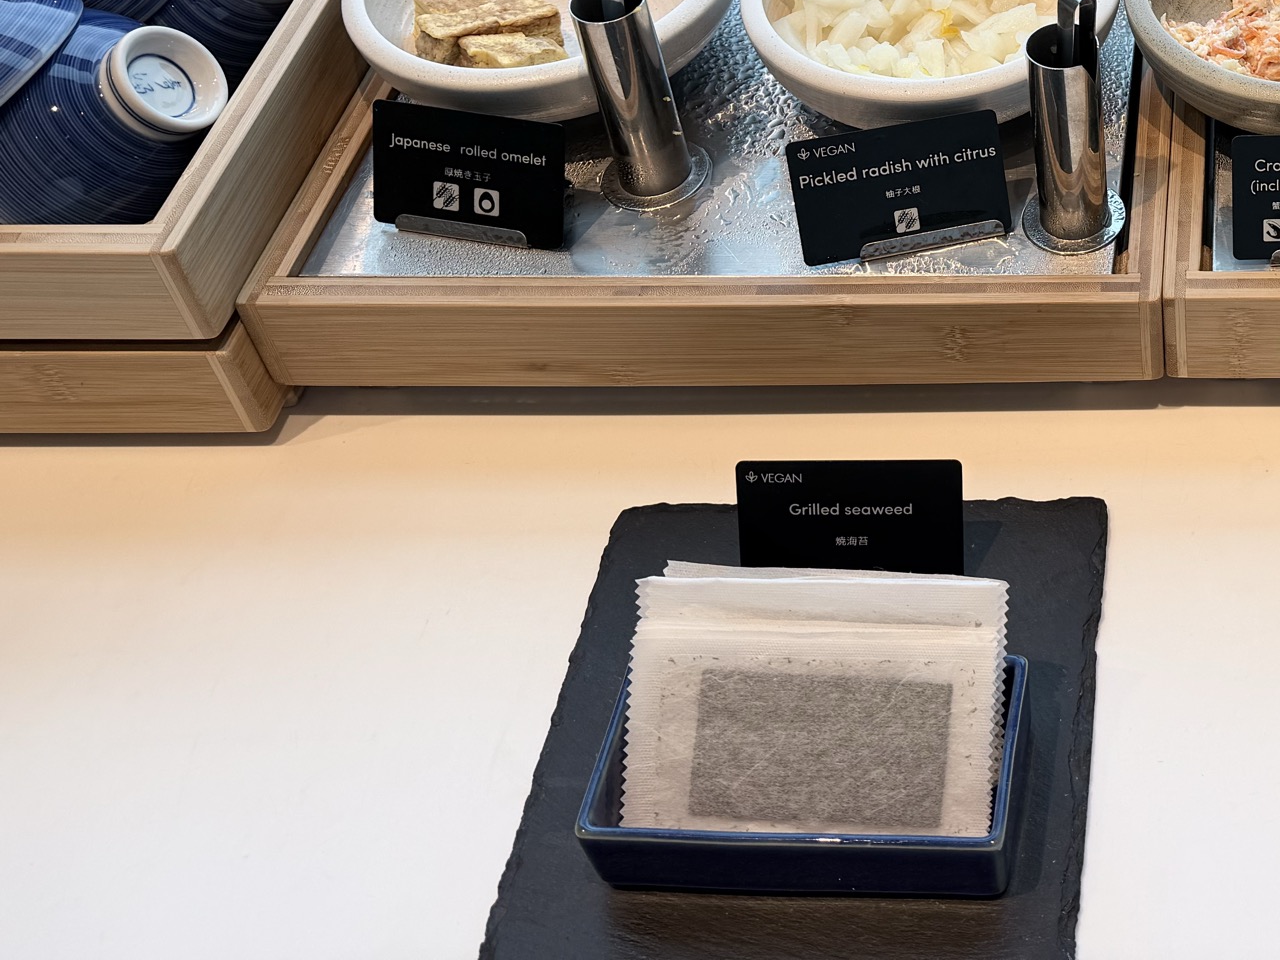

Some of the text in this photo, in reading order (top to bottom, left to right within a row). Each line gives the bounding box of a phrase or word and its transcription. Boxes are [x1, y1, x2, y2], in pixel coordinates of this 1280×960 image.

[389, 133, 546, 166] Japanese rolled omelet
[812, 142, 856, 159] VEGAN
[444, 167, 491, 182] 厚焼き玉子
[798, 145, 996, 190] Pickled radish with citrus
[885, 185, 921, 199] 柚子大根
[761, 473, 802, 483] VEGAN
[789, 503, 913, 516] Grilled seaweed
